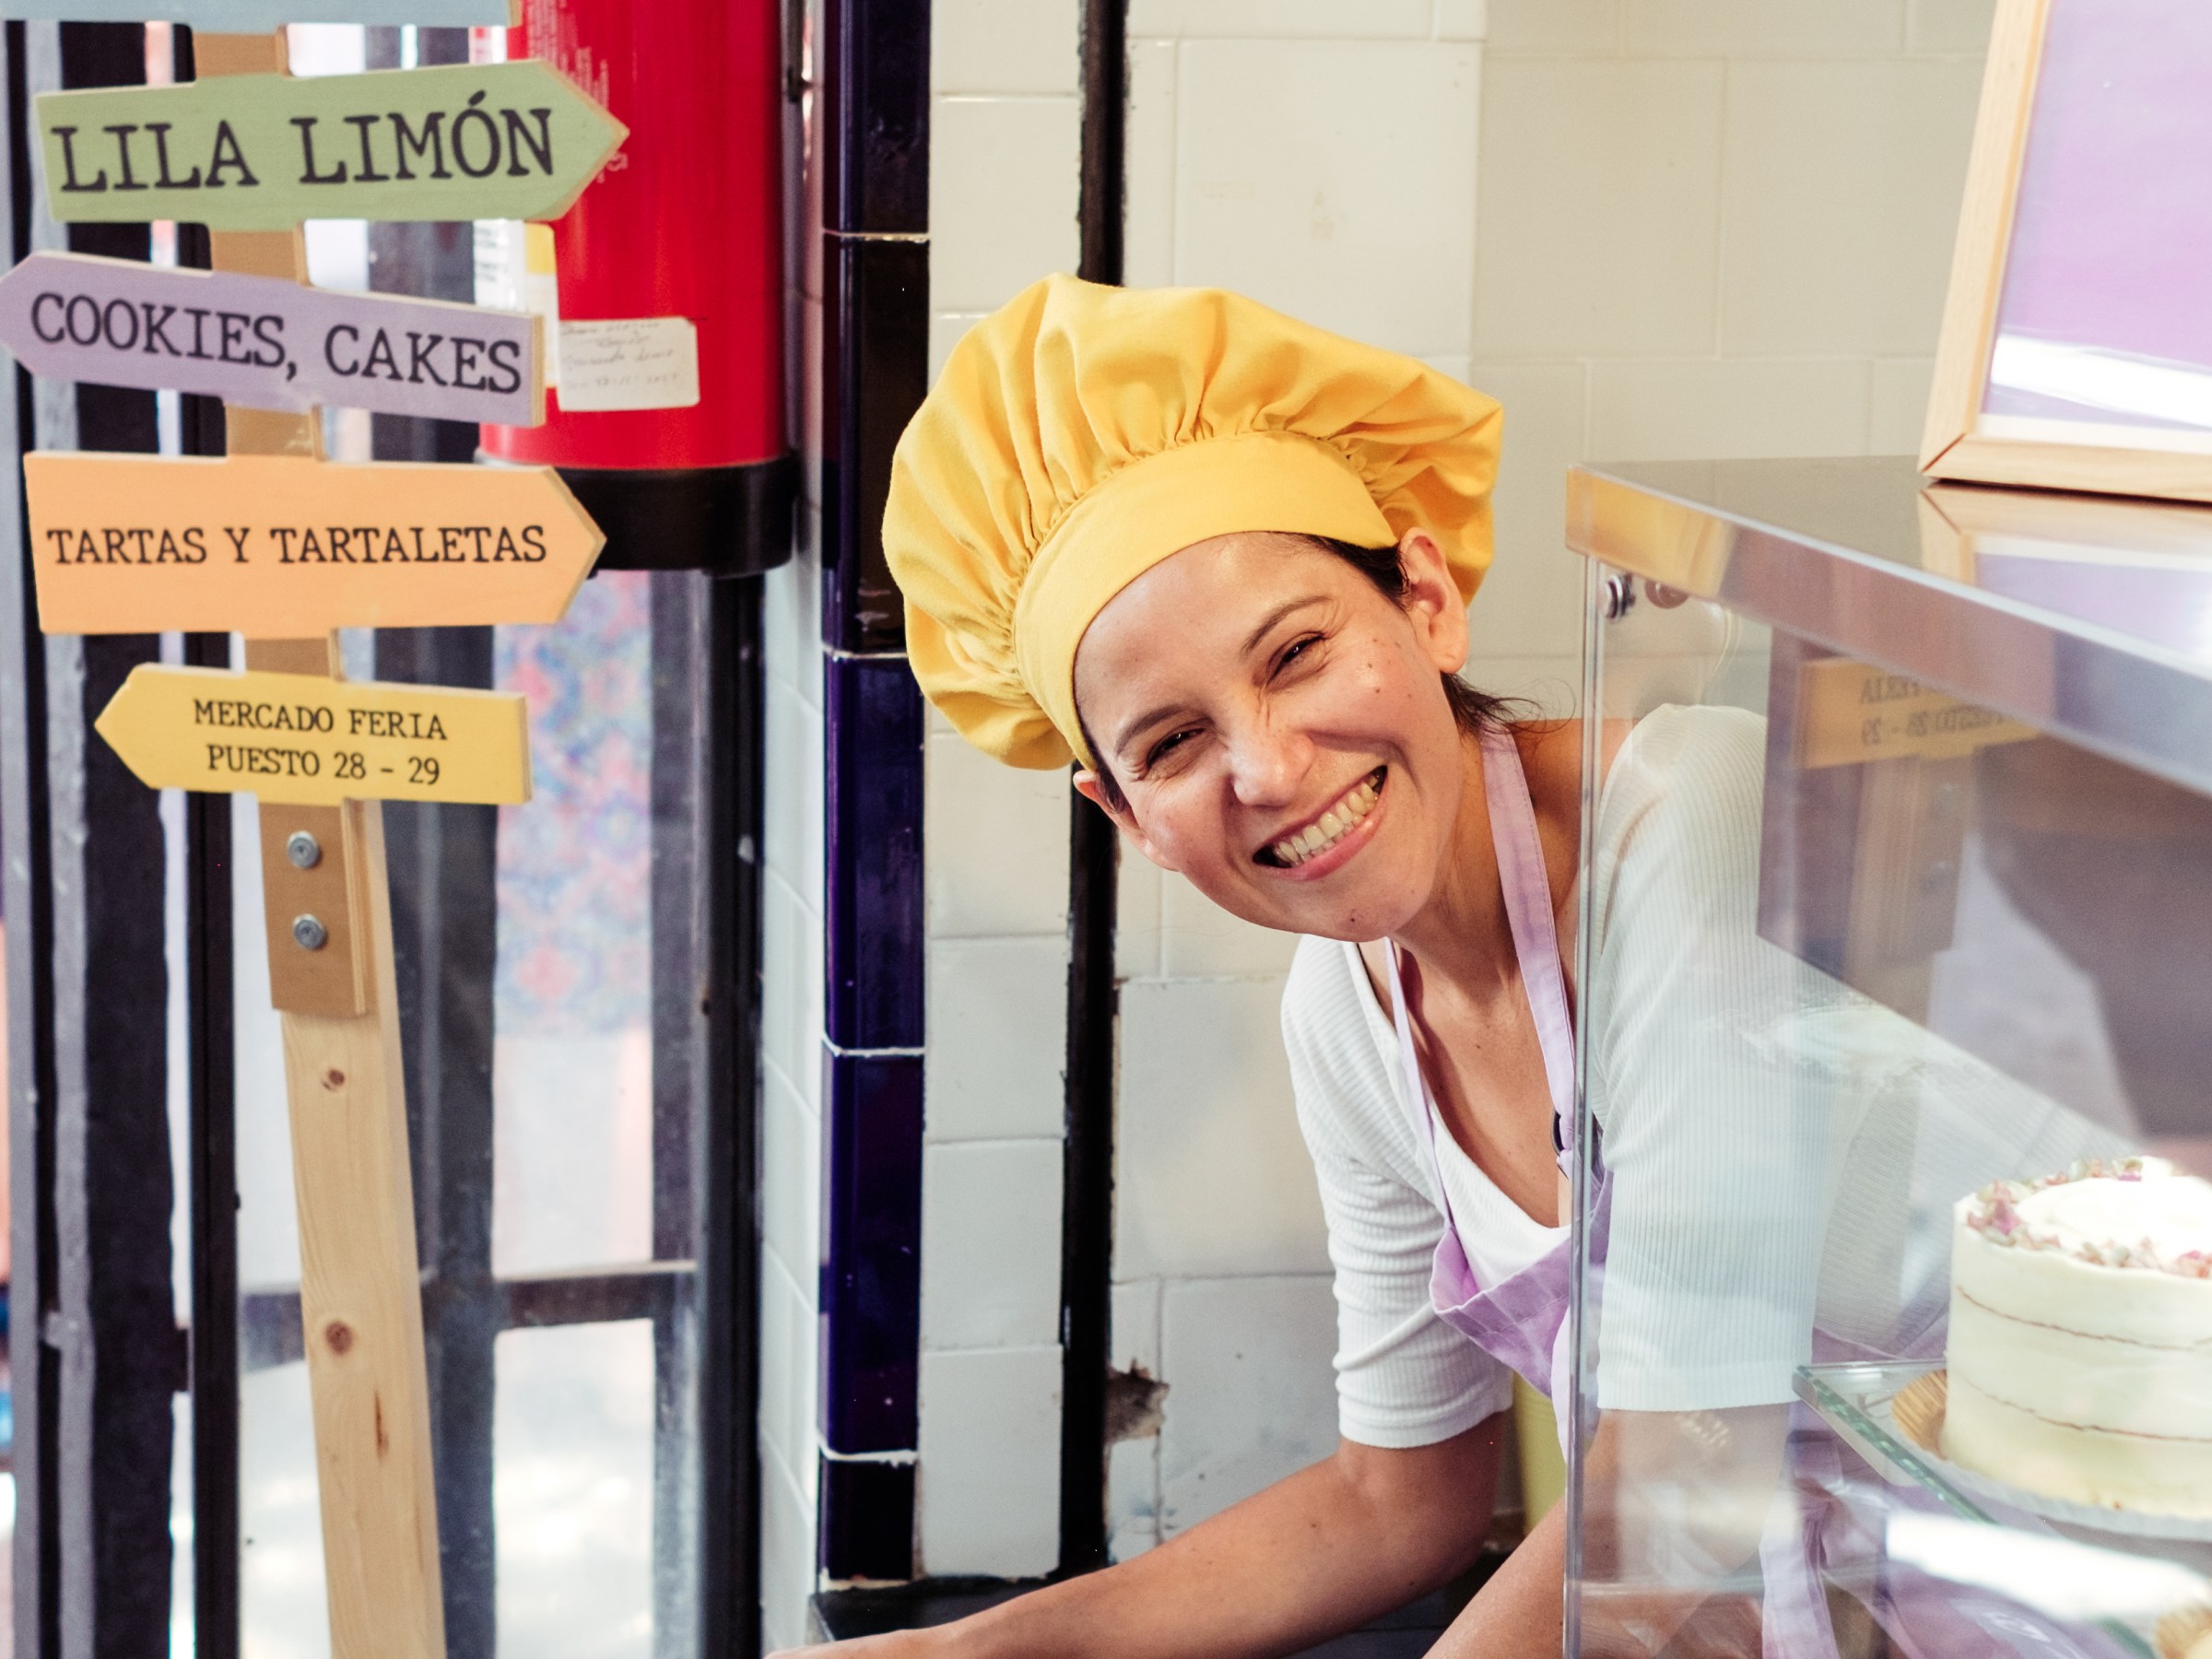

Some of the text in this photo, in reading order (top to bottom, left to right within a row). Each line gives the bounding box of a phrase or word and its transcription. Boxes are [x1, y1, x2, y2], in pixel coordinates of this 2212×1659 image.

[51, 120, 259, 193] LILA
[289, 89, 554, 184] LIMÓN
[29, 292, 522, 394] COOKIES, CAKES
[46, 524, 547, 564] TARTAS Y TARTALETAS
[194, 700, 448, 740] MERCADO FERIA
[207, 744, 321, 775] PUESTO
[335, 753, 367, 780] 28
[408, 758, 441, 785] 29
